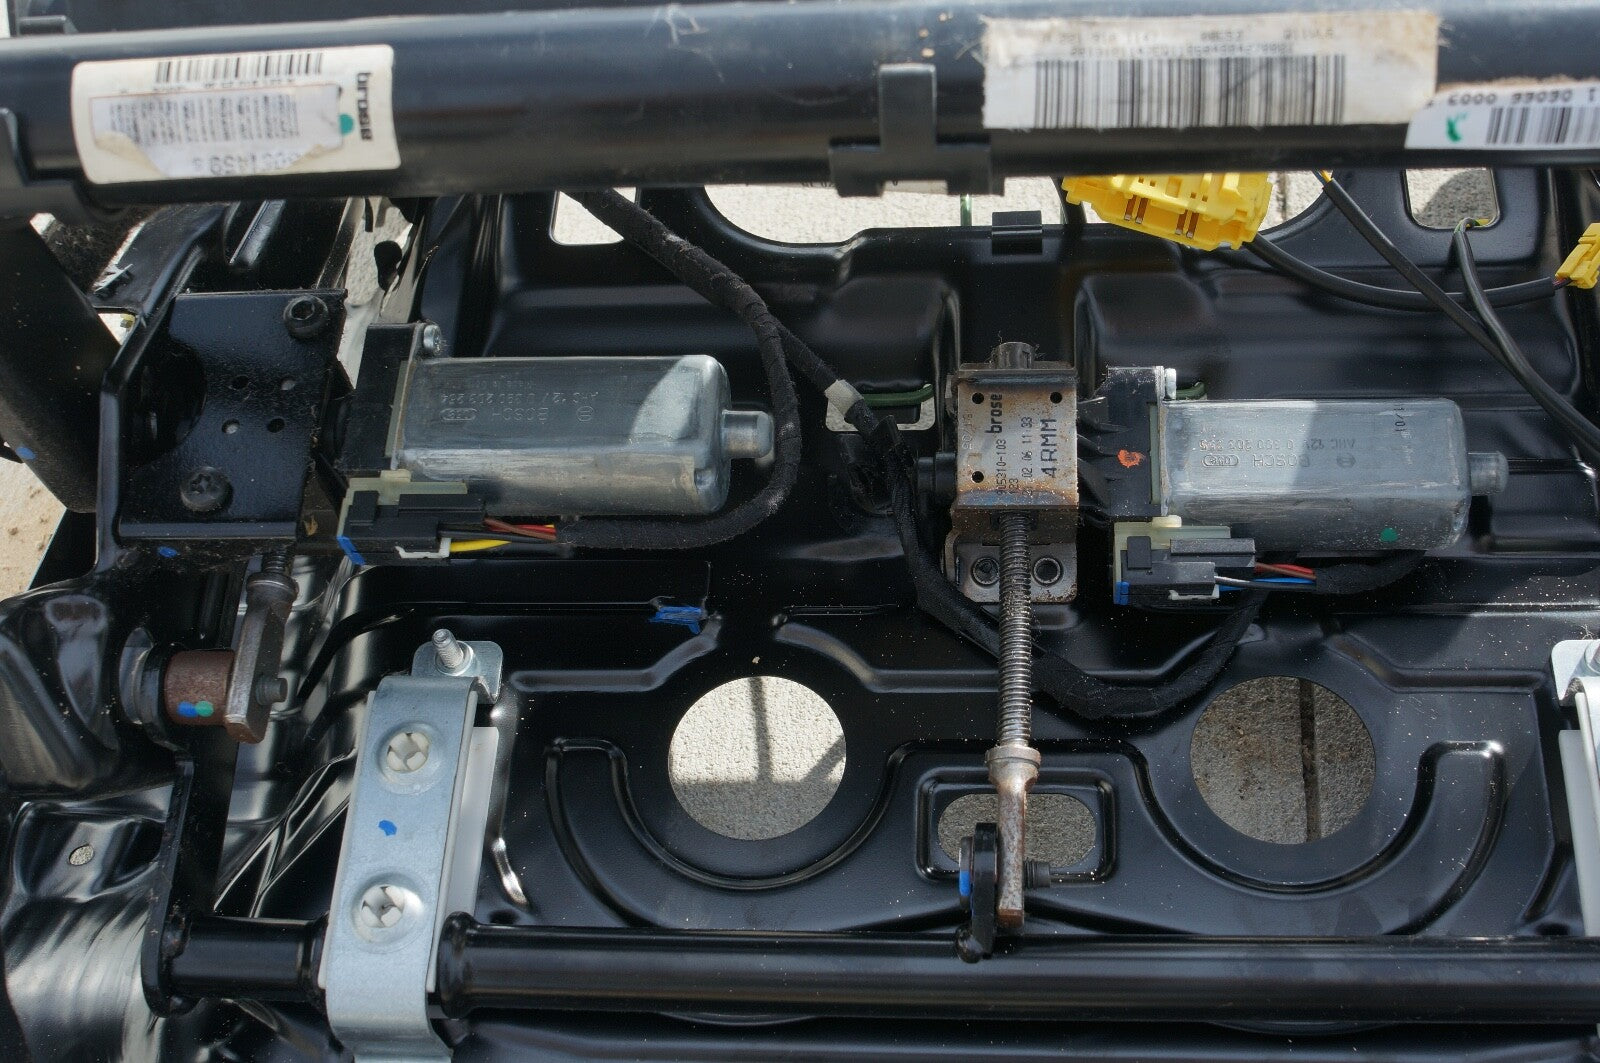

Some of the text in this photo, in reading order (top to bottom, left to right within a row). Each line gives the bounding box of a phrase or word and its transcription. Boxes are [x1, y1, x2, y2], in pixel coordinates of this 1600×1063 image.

[357, 72, 373, 142] brose
[985, 393, 1003, 434] brose
[1040, 419, 1058, 478] 4RMM
[1252, 453, 1310, 469] BOSCH
